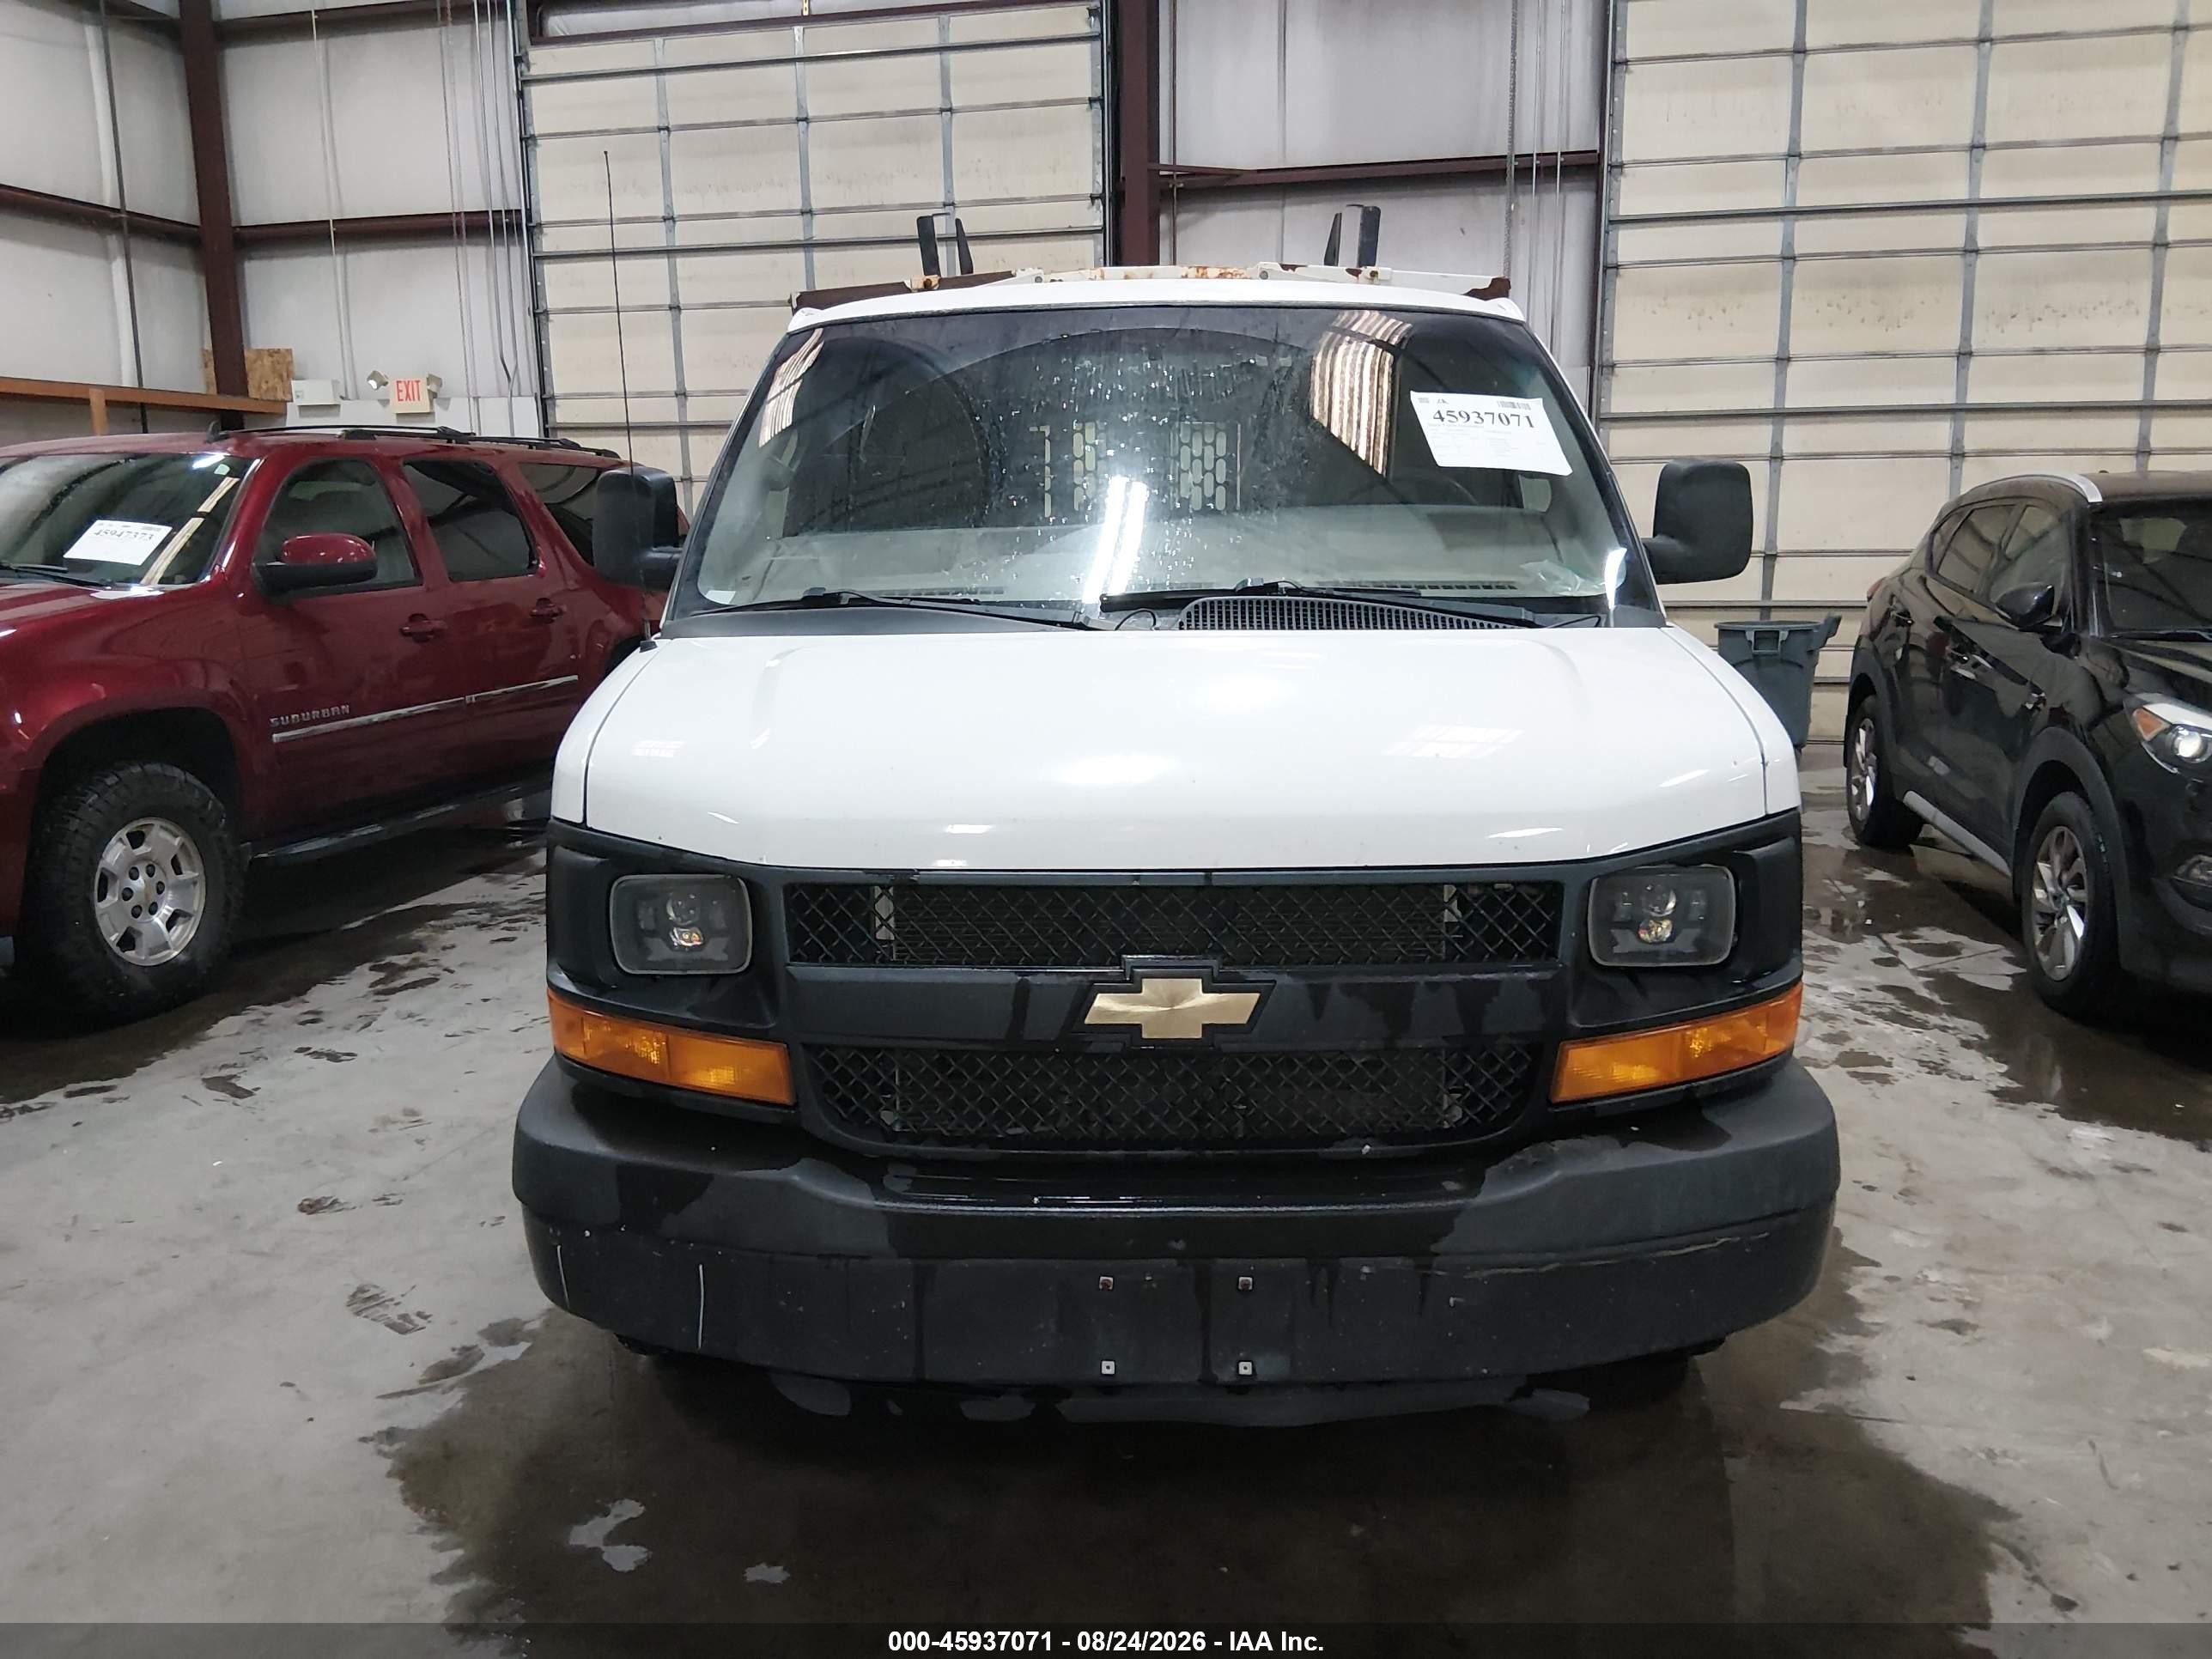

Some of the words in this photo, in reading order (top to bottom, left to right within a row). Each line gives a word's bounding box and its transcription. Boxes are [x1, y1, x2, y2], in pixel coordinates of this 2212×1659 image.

[396, 380, 421, 402] EXIT
[1433, 409, 1534, 428] 45937071
[270, 704, 349, 726] SUBURBAN
